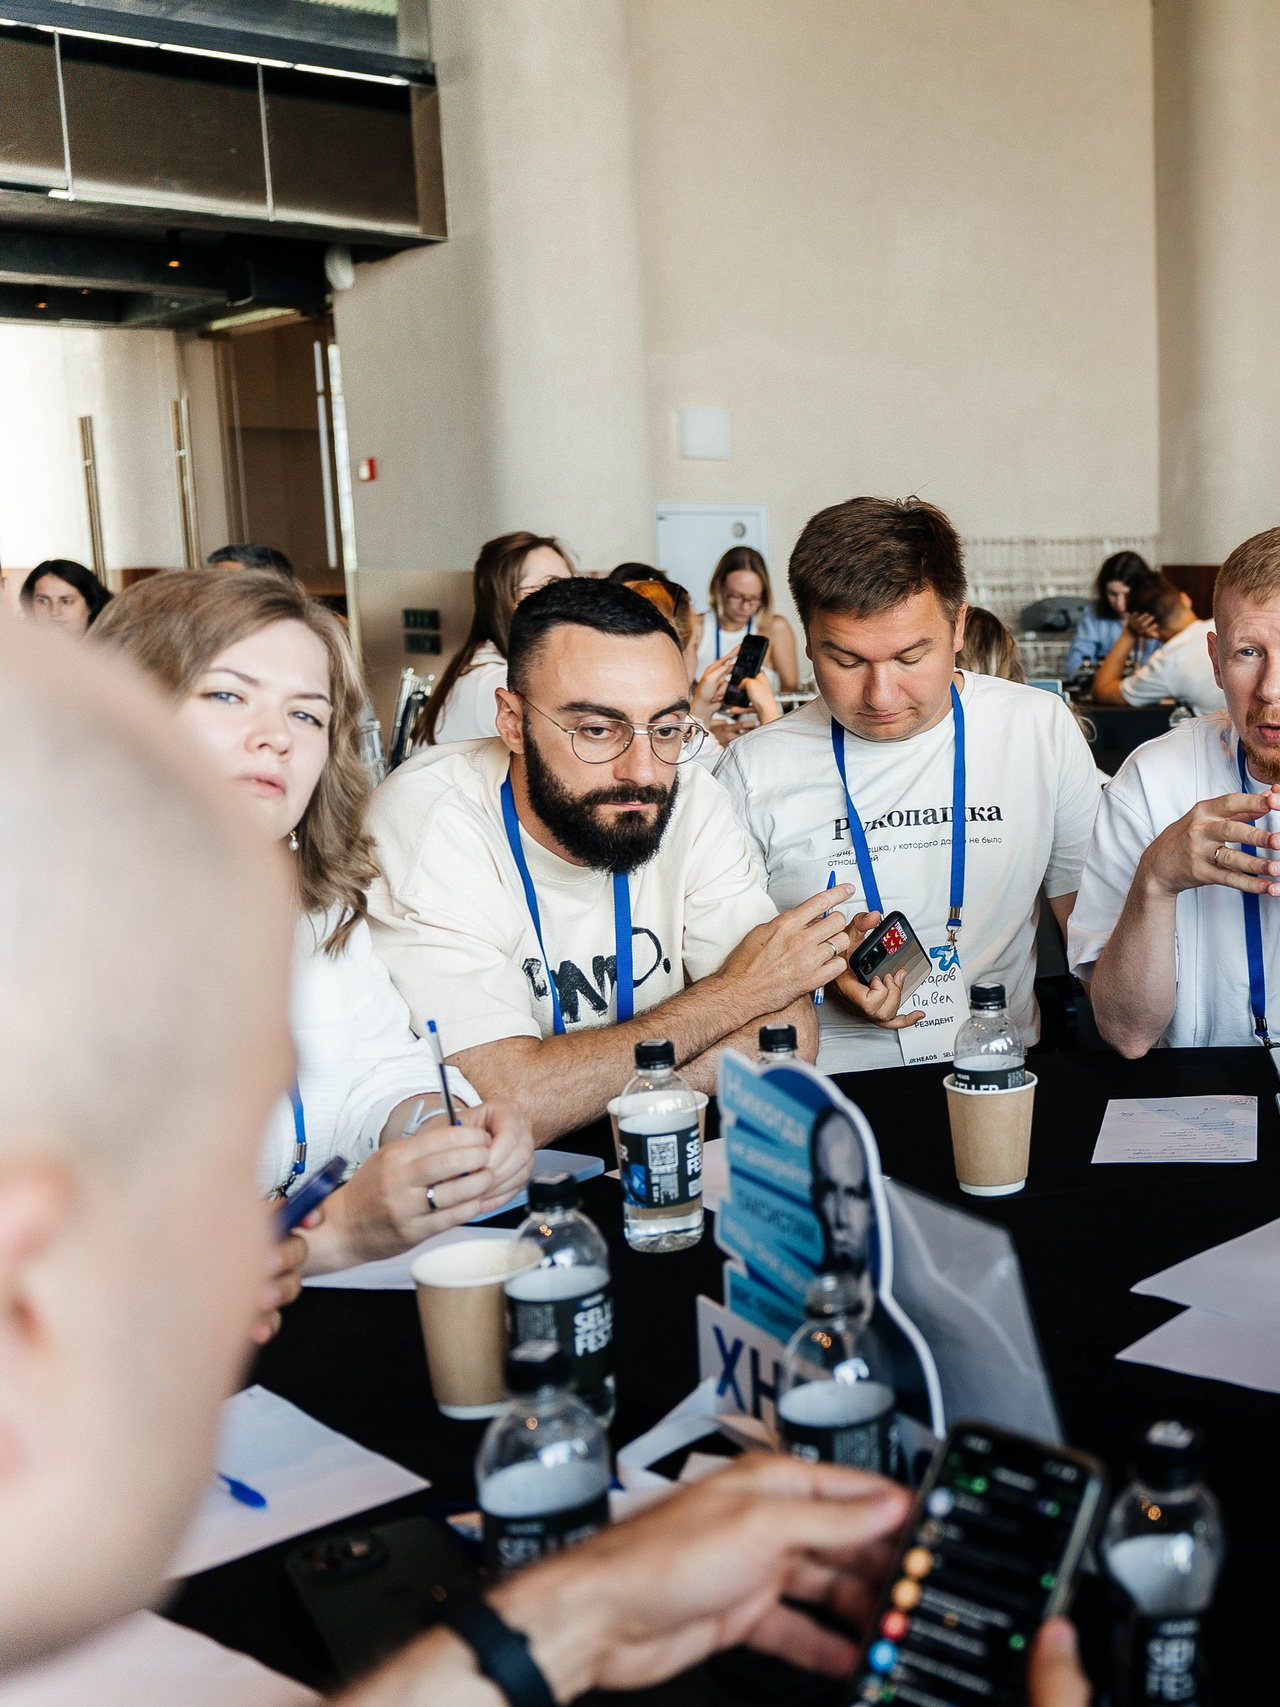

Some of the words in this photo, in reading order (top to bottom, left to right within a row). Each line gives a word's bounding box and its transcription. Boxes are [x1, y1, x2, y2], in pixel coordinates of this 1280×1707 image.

[899, 840, 938, 850] которого
[982, 836, 1002, 844] было
[911, 991, 954, 1007] Павел
[914, 1016, 954, 1028] РЕЗИДЕНТ
